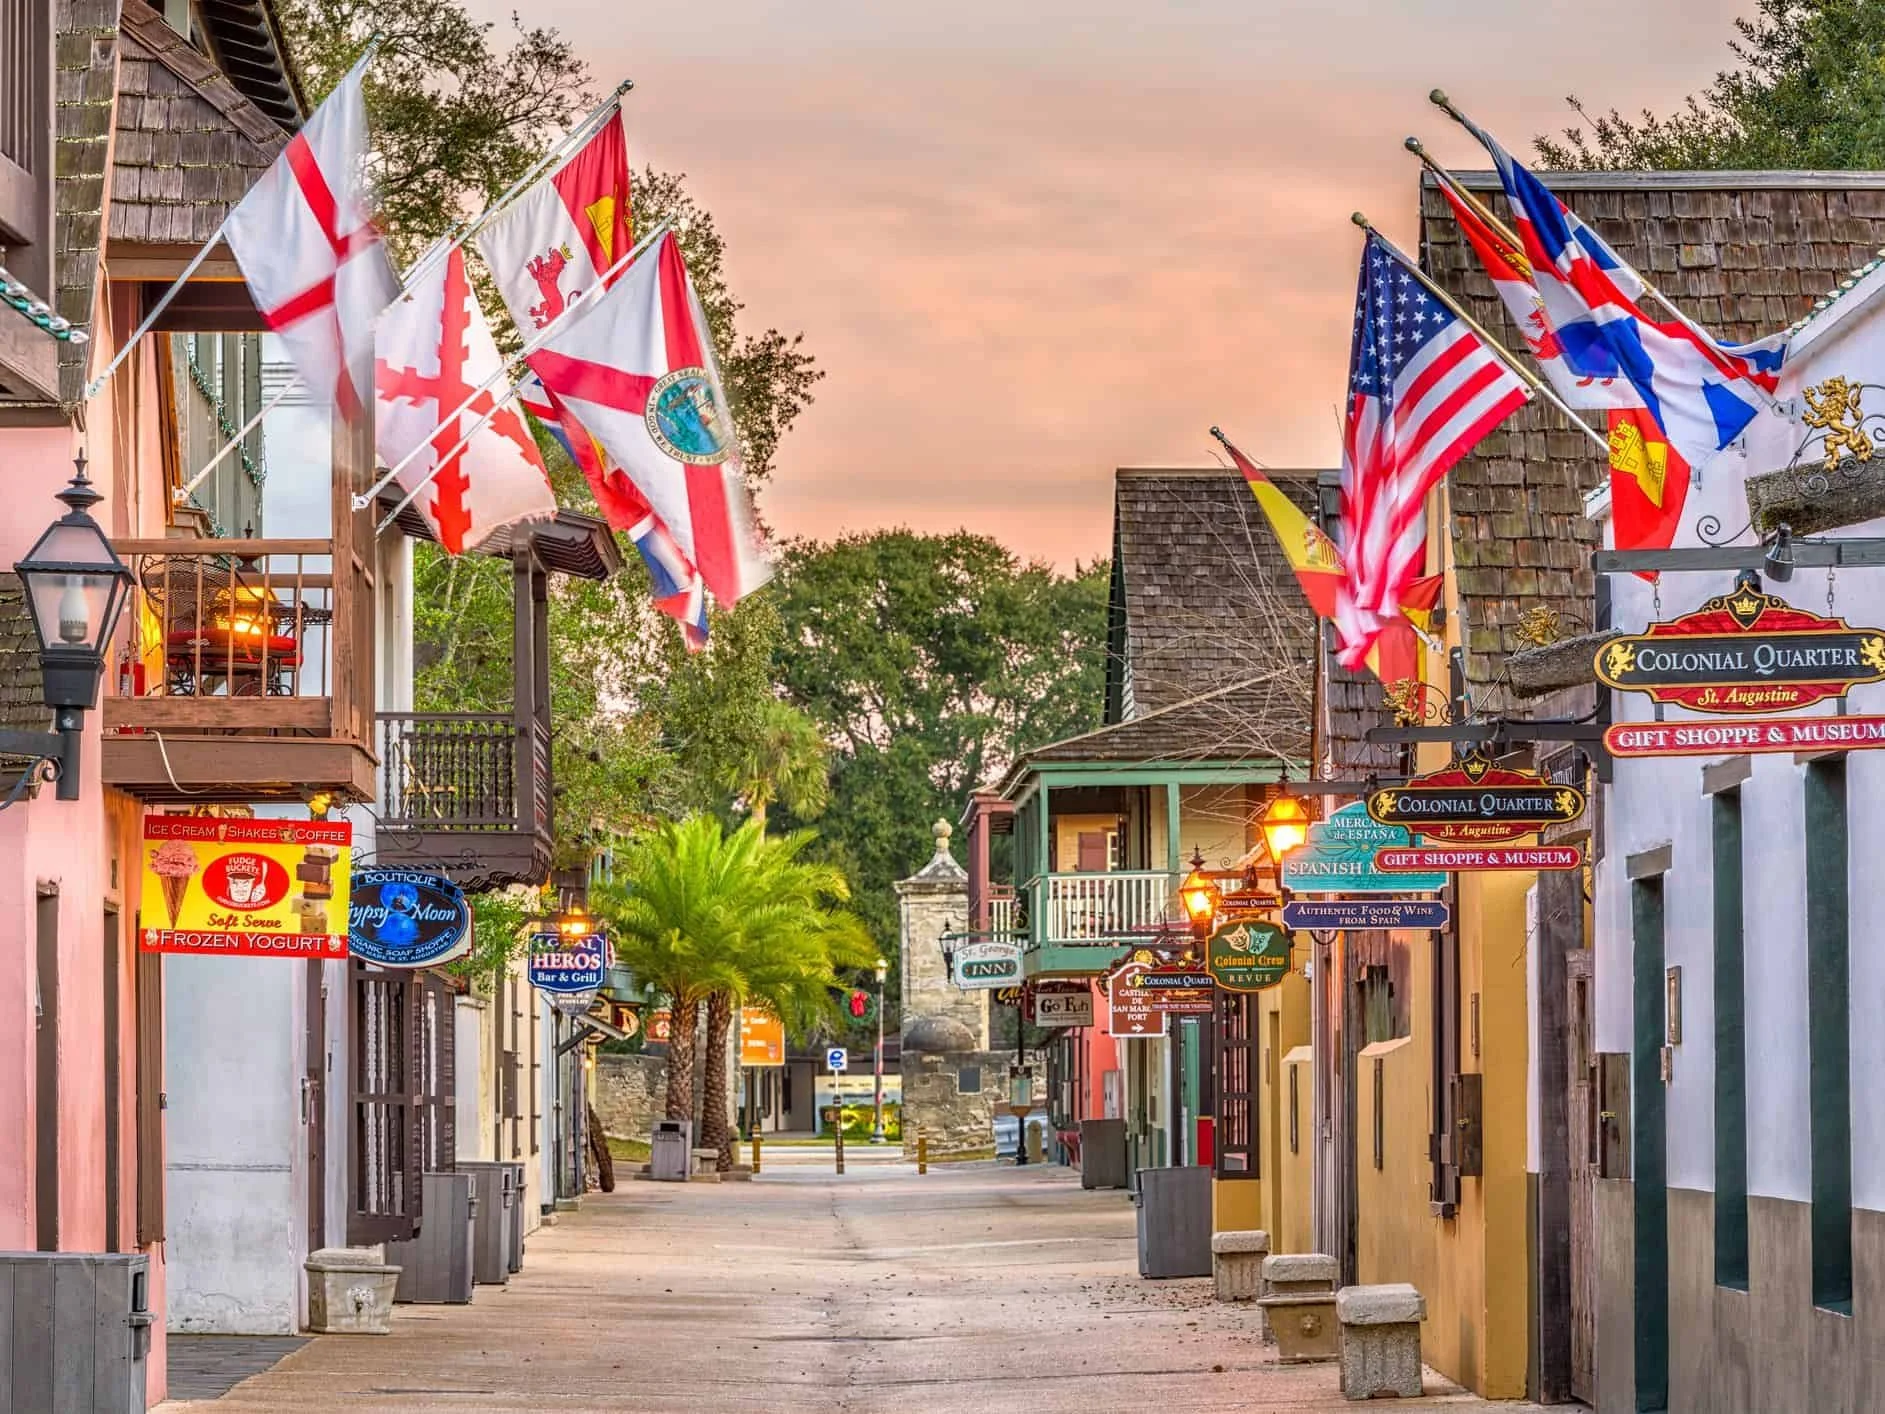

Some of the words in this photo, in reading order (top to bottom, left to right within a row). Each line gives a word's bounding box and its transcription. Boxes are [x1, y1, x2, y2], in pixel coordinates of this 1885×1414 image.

[1636, 649, 1748, 671] COLONIAL
[1754, 644, 1860, 675] QUARTER
[1697, 688, 1719, 705] St.
[1724, 686, 1798, 706] Augustine
[1618, 730, 1667, 748] GIFT
[1676, 727, 1758, 746] SHOPPE
[1767, 726, 1785, 743] &
[1791, 723, 1885, 742] MUSEUM
[1398, 796, 1476, 813] COLONIAL
[1479, 794, 1554, 816] QUARTER
[148, 824, 168, 836] ICE
[171, 824, 215, 837] CREAM
[227, 825, 277, 839] SHAKES
[295, 827, 345, 842] COFFEE
[1334, 829, 1345, 840] de
[1440, 825, 1456, 837] St.
[1459, 823, 1511, 838] Augustine
[228, 857, 257, 865] FUDGE
[1384, 853, 1419, 866] GIFT
[1425, 852, 1485, 866] SHOPPE
[1487, 853, 1498, 865] &
[1505, 851, 1572, 865] MUSEUM
[1288, 862, 1362, 876] SPANISH
[364, 872, 437, 887] BOUTIQUE
[410, 903, 456, 921] Moon
[1298, 905, 1357, 916] AUTHENTIC
[1404, 905, 1434, 916] WINE
[207, 912, 239, 930] Soft
[242, 914, 282, 929] Serve
[1370, 915, 1400, 925] SPAIN
[160, 931, 239, 948] FROZEN
[245, 933, 326, 952] YOGURT
[386, 949, 413, 957] SOAP
[415, 931, 450, 954] SHOPPE
[532, 952, 601, 970] HEROS
[1215, 955, 1255, 968] Colonial
[537, 972, 555, 982] Bar
[559, 972, 569, 982] &
[571, 972, 597, 982] Grill
[972, 963, 1006, 976] INN
[1144, 977, 1181, 985] COLONIAL
[1229, 974, 1271, 983] REVUE
[1040, 998, 1060, 1013] Go
[1131, 997, 1143, 1005] DE
[1127, 1013, 1147, 1021] FORT
